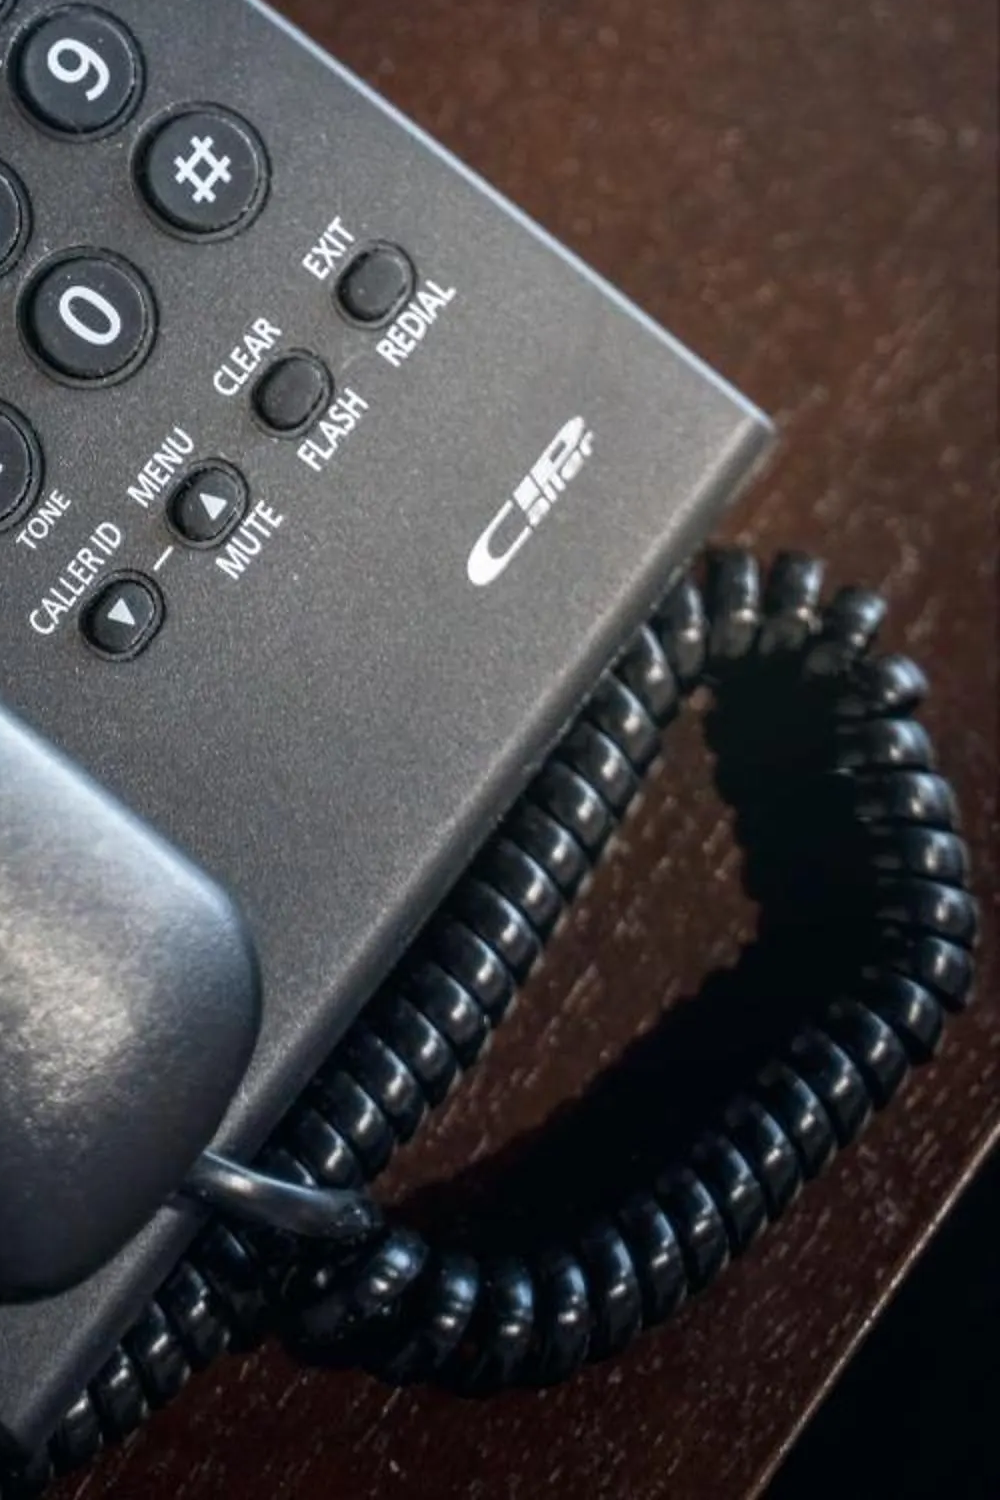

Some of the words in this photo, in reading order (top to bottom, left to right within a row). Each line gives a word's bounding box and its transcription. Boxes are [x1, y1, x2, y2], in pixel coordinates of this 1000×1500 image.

[47, 37, 110, 101] 9
[301, 215, 355, 281] EXIT
[58, 285, 122, 345] 0
[375, 280, 457, 367] REDIAL
[213, 317, 282, 396] CLEAR
[126, 426, 195, 508] MENU
[296, 387, 369, 472] FLASH
[15, 488, 72, 549] TONE
[215, 499, 285, 580] MUTE
[29, 547, 106, 635] CALLER
[89, 521, 122, 556] ID
